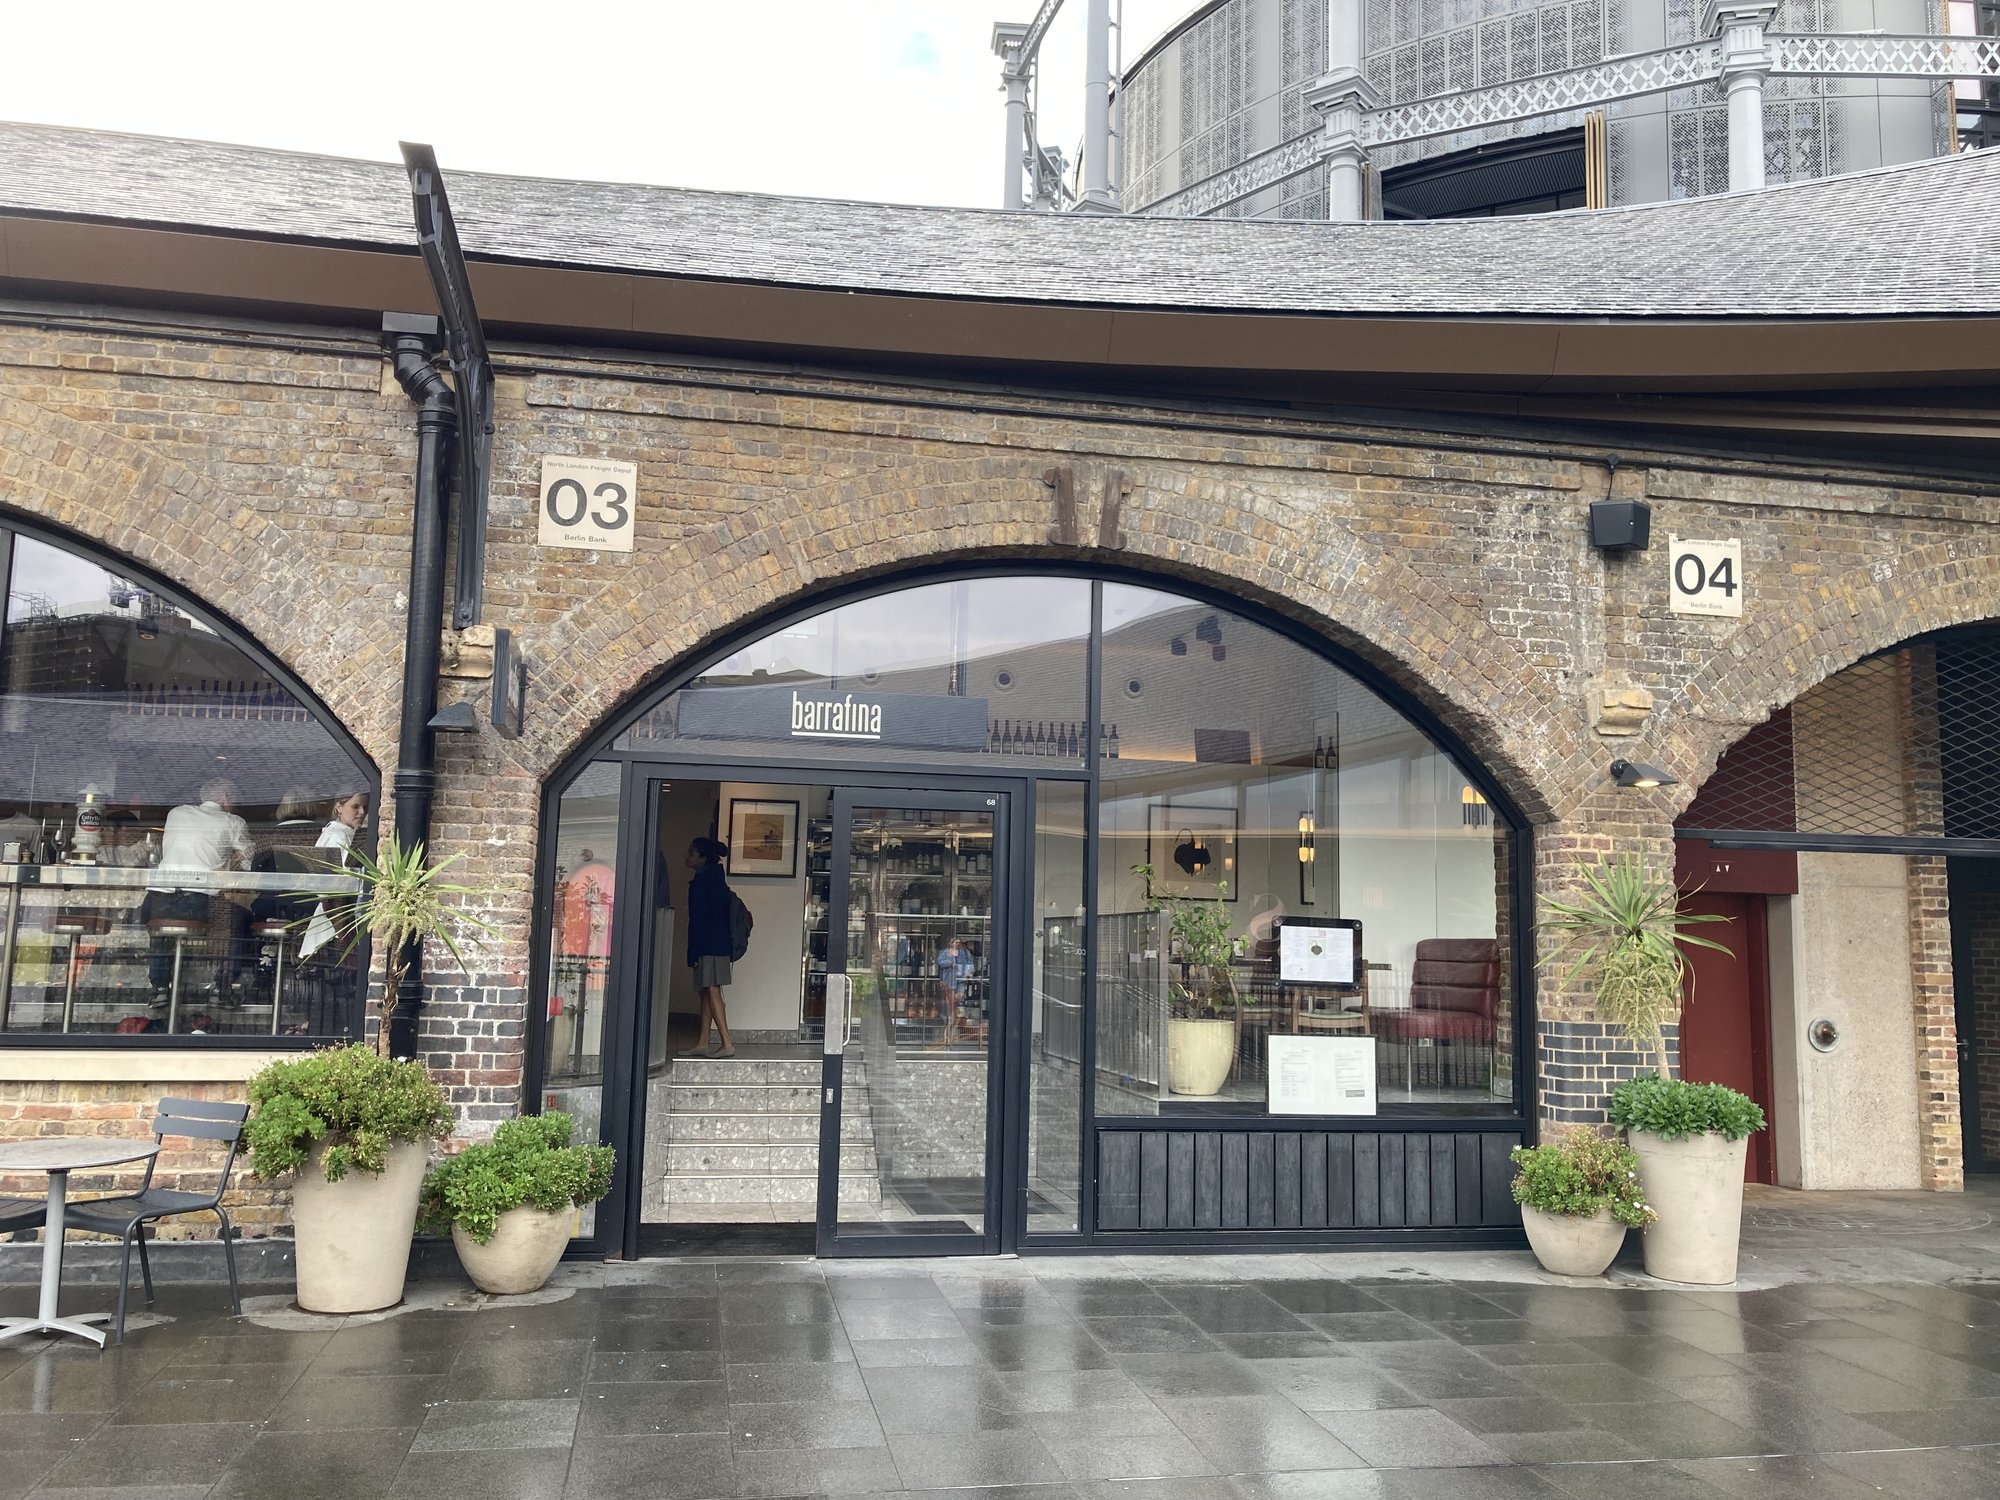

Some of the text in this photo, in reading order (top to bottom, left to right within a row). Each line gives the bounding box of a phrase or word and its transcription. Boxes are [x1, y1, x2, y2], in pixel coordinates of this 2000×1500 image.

[590, 465, 612, 473] Freight
[613, 466, 632, 474] Depot
[546, 478, 629, 530] 03
[564, 533, 607, 543] Berlin Bank
[1674, 553, 1738, 597] 04
[791, 690, 882, 733] barrafina
[986, 798, 996, 806] 68
